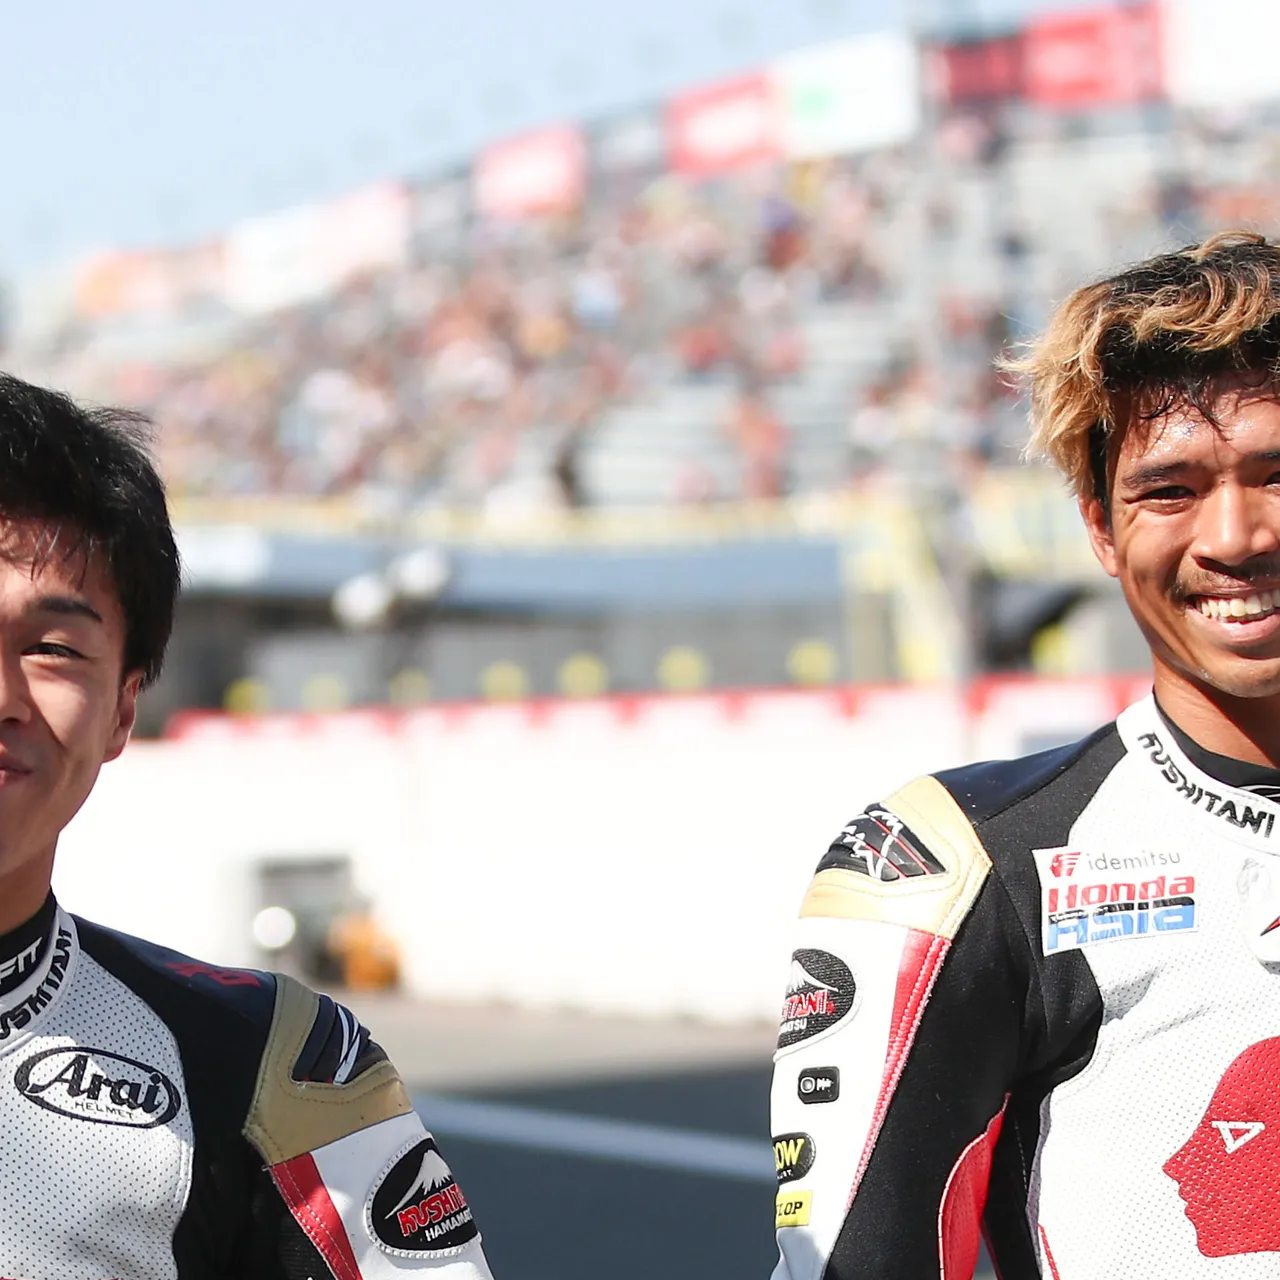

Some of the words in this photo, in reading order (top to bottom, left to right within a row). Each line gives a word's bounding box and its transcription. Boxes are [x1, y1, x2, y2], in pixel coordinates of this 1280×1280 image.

[1087, 850, 1181, 871] idemitsu
[1048, 875, 1195, 912] Honda
[28, 1054, 164, 1113] Arai
[74, 1101, 134, 1120] HELMET
